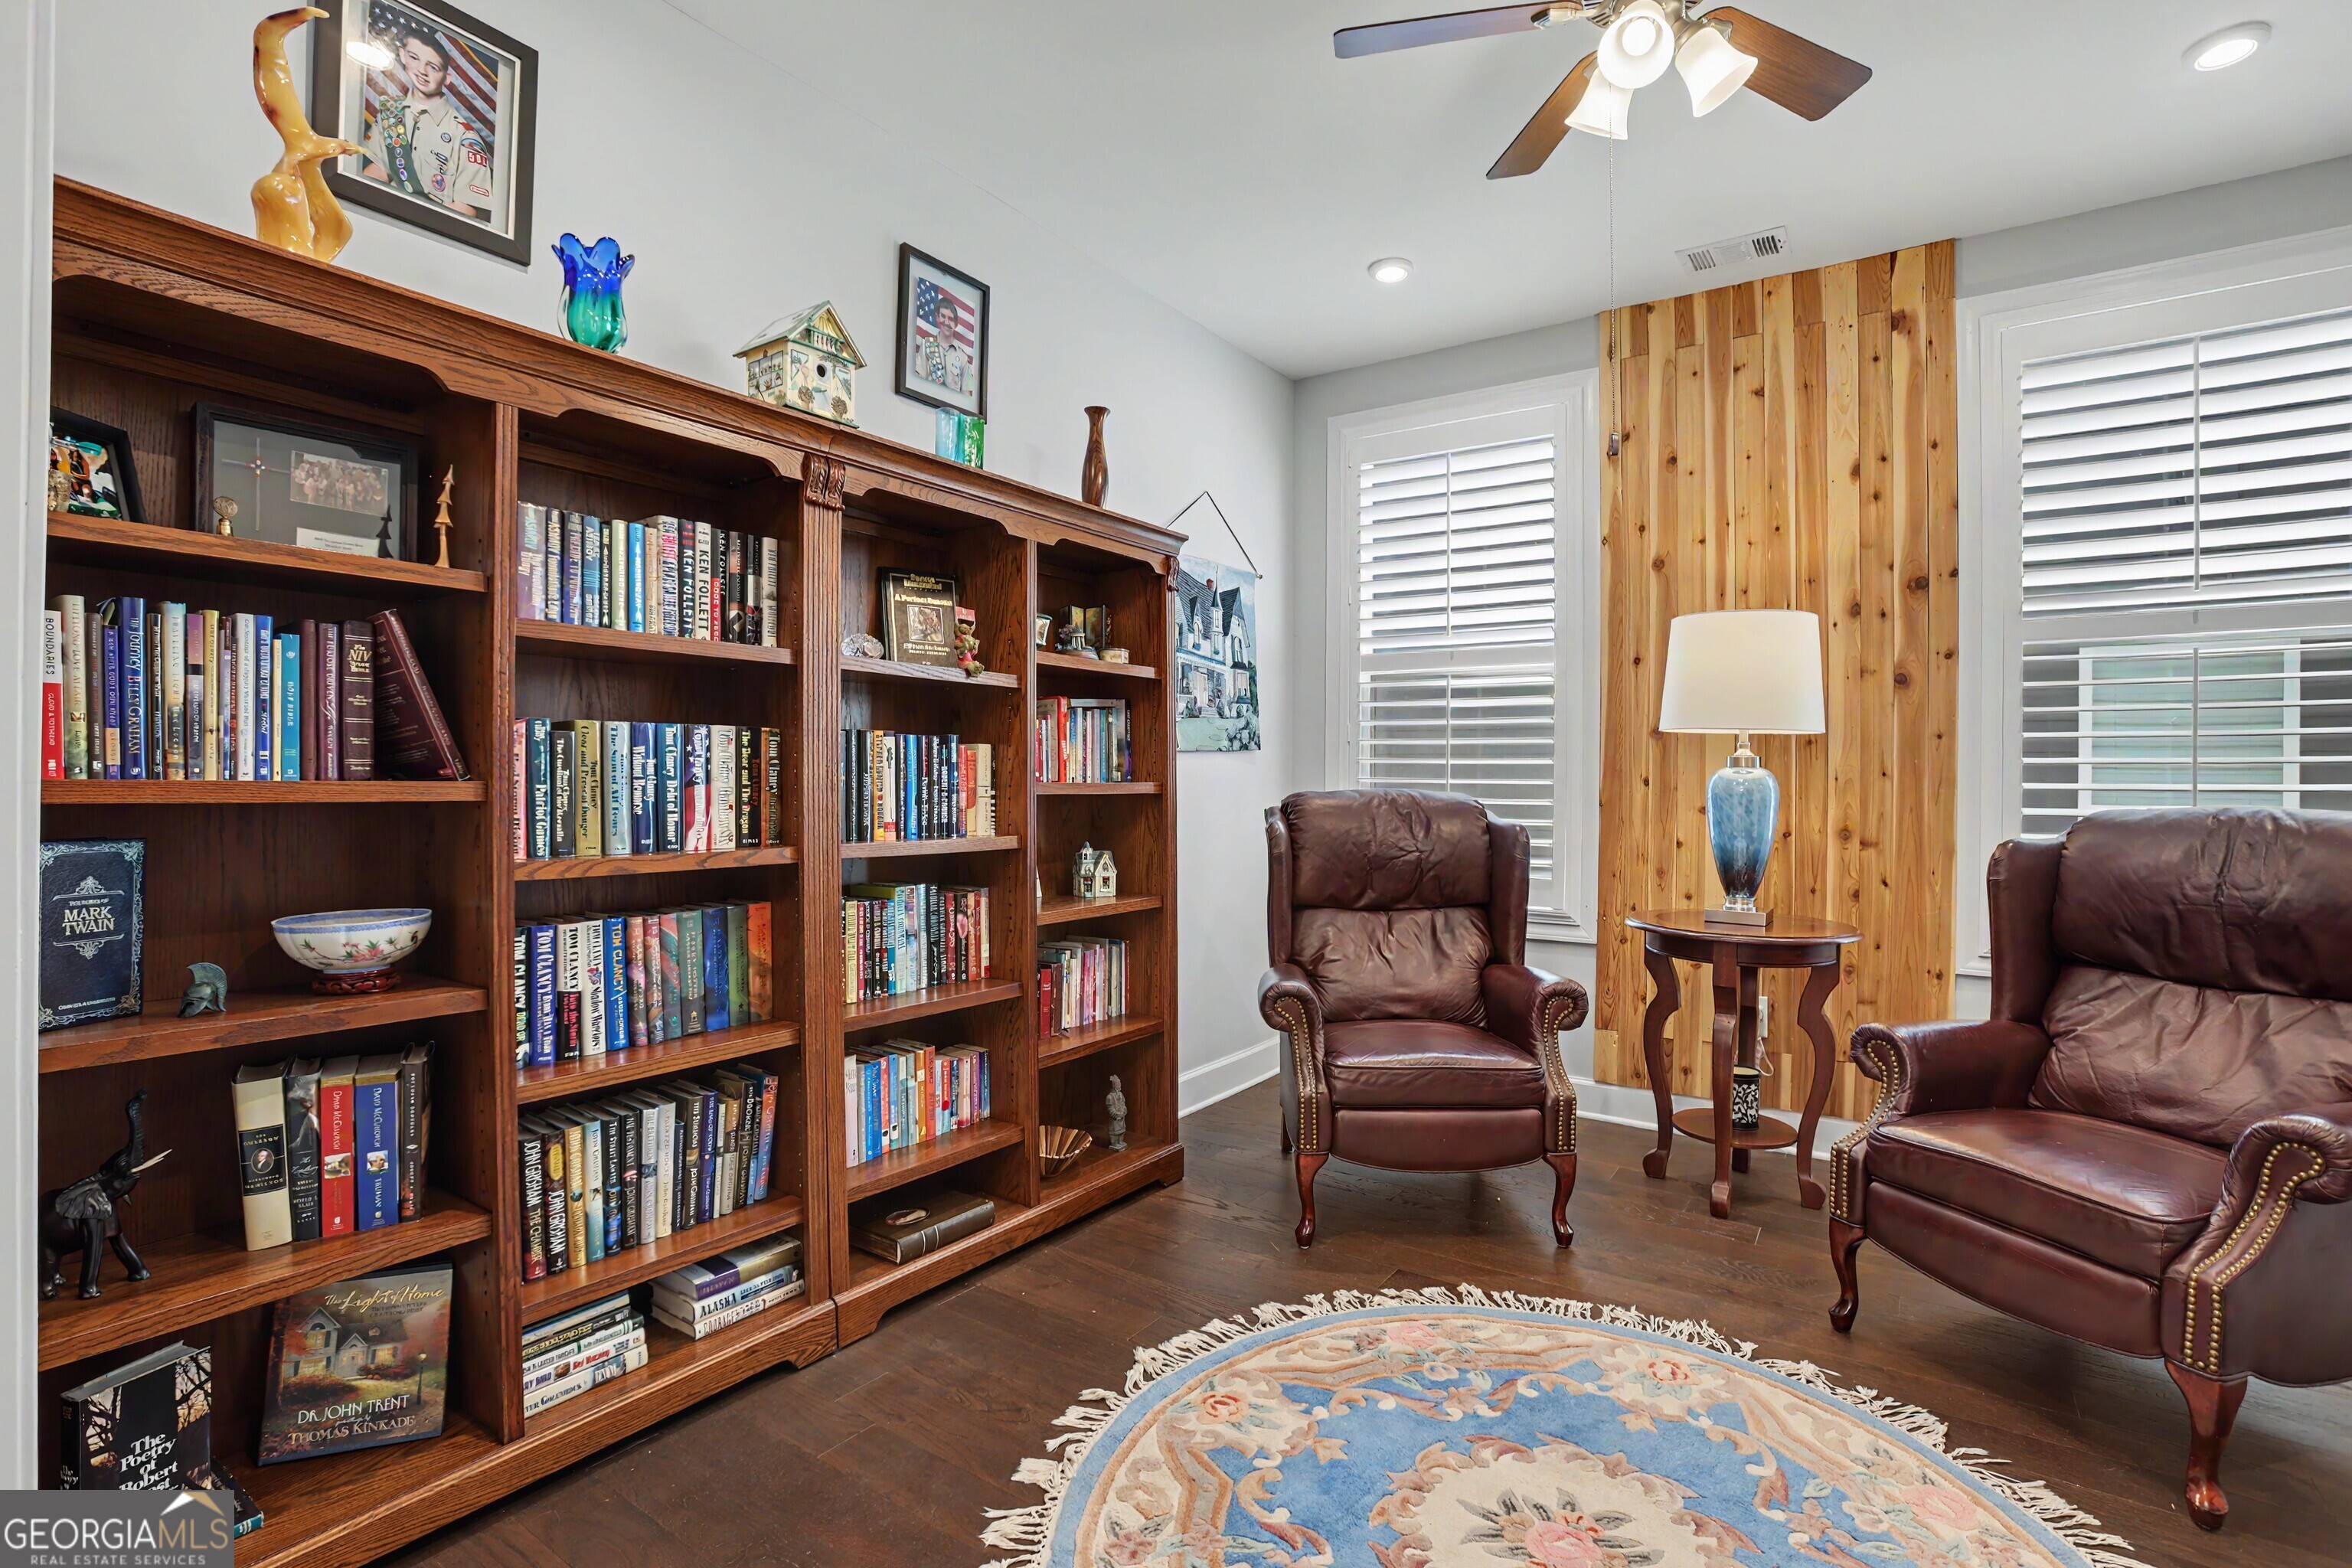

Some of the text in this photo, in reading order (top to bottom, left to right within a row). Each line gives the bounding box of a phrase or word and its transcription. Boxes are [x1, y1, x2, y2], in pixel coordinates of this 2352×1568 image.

[683, 549, 694, 630] KEN FOLLETT
[698, 550, 710, 632] KEN FOLLETT
[45, 617, 55, 675] BOUNDARIES
[71, 649, 82, 671] LOVE
[348, 650, 372, 662] NIV
[128, 675, 142, 753] BILLY GRAHAM
[741, 730, 751, 746] The
[662, 746, 678, 777] Clancy
[766, 735, 781, 795] Tom Clancy
[741, 769, 750, 785] and
[750, 779, 760, 806] Clancy
[535, 784, 548, 856] Patriot Games
[666, 780, 678, 842] Debt of Honor
[739, 805, 751, 834] Dragon
[62, 918, 116, 936] TWAIN
[64, 906, 113, 922] MARK
[514, 935, 526, 960] TOM
[612, 923, 622, 946] TOM
[537, 929, 554, 995] TOM CLANCY
[569, 927, 579, 989] TOM CLANCY
[612, 949, 624, 991] CLANCY
[524, 1141, 543, 1207] JOHN GRISHAM
[548, 1189, 564, 1213] JOHN
[528, 1208, 541, 1226] THE
[548, 1214, 566, 1255] GRISHAM
[325, 1295, 341, 1306] The
[338, 1289, 394, 1314] Light
[402, 1282, 446, 1303] Home
[322, 1394, 410, 1423] JOHN TRENT
[130, 1433, 166, 1454] The
[288, 1426, 350, 1446] THOMAS
[119, 1437, 176, 1474] Poetry
[139, 1458, 157, 1476] of
[119, 1461, 178, 1490] Robert
